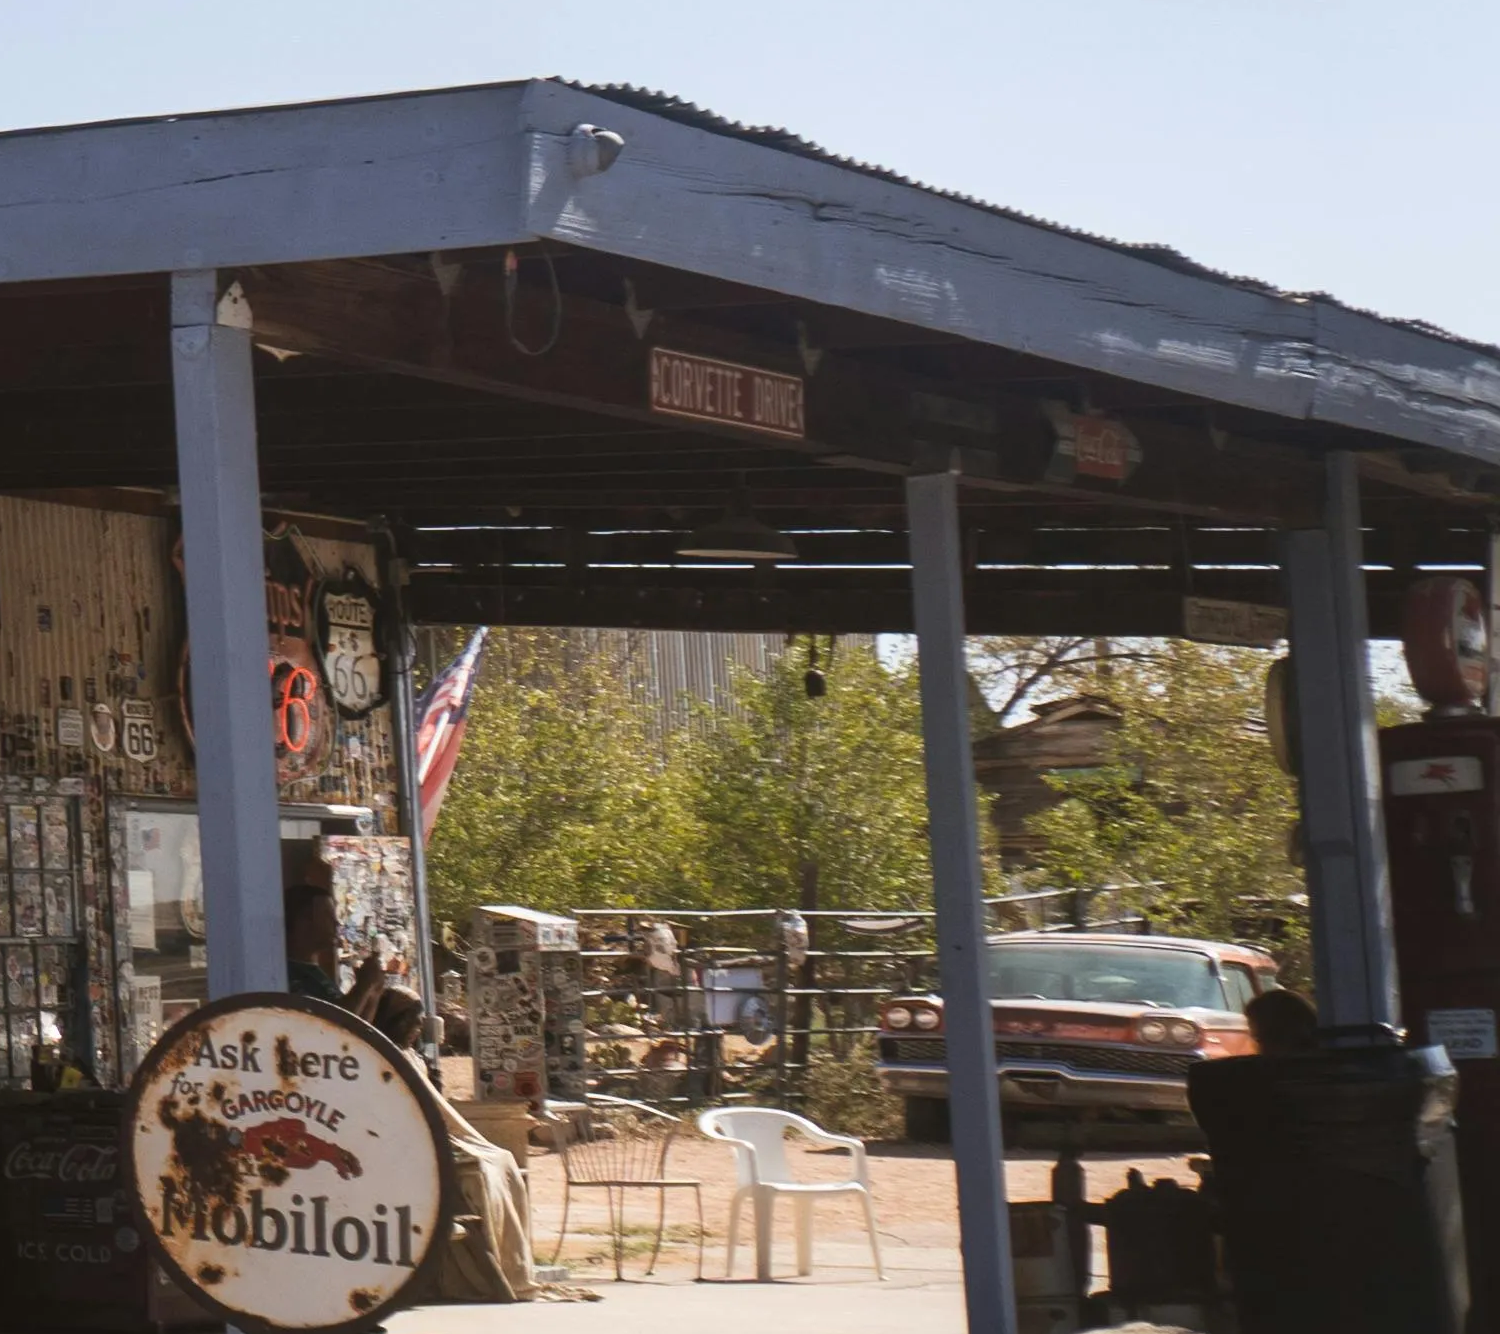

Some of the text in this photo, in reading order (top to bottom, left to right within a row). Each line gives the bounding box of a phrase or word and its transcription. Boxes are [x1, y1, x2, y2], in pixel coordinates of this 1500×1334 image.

[660, 355, 798, 429] CORVETTE DRIVE
[327, 599, 369, 624] ROUTE
[333, 652, 368, 699] 66
[128, 722, 154, 755] 66
[194, 1031, 263, 1073] Ask
[220, 1089, 346, 1134] GARGOYLE
[158, 1176, 419, 1268] Mobiloil
[55, 1243, 112, 1264] COLD
